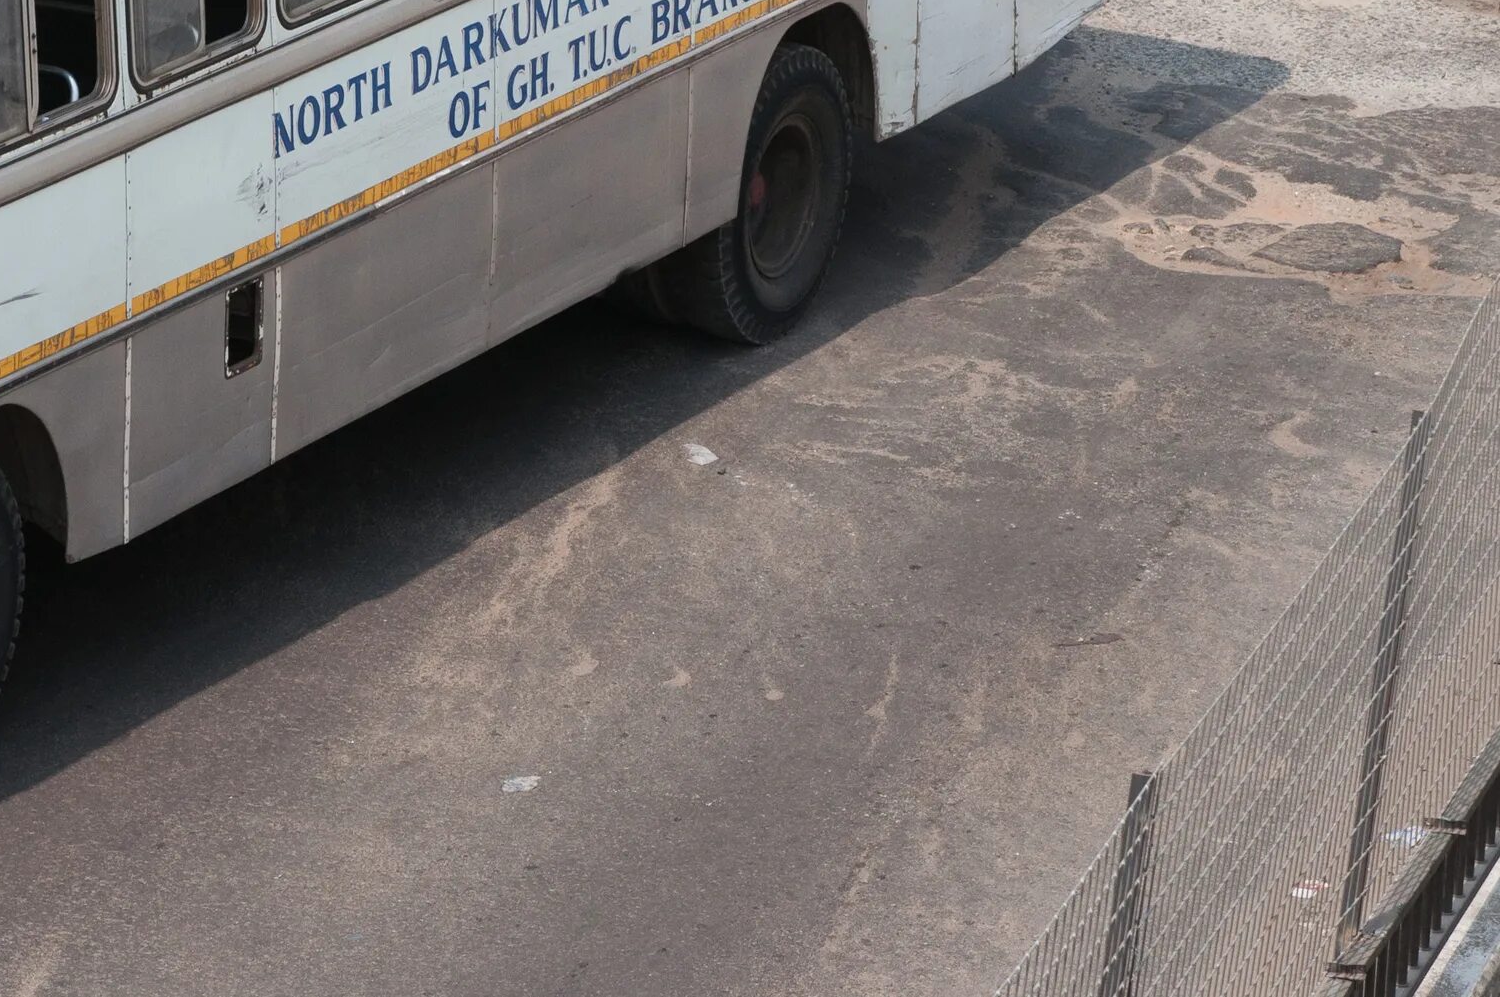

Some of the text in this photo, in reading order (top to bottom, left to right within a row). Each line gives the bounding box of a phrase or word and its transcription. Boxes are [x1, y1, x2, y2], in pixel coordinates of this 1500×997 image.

[272, 61, 393, 159] NORTH
[449, 80, 490, 138] OF
[507, 51, 555, 110] GH.
